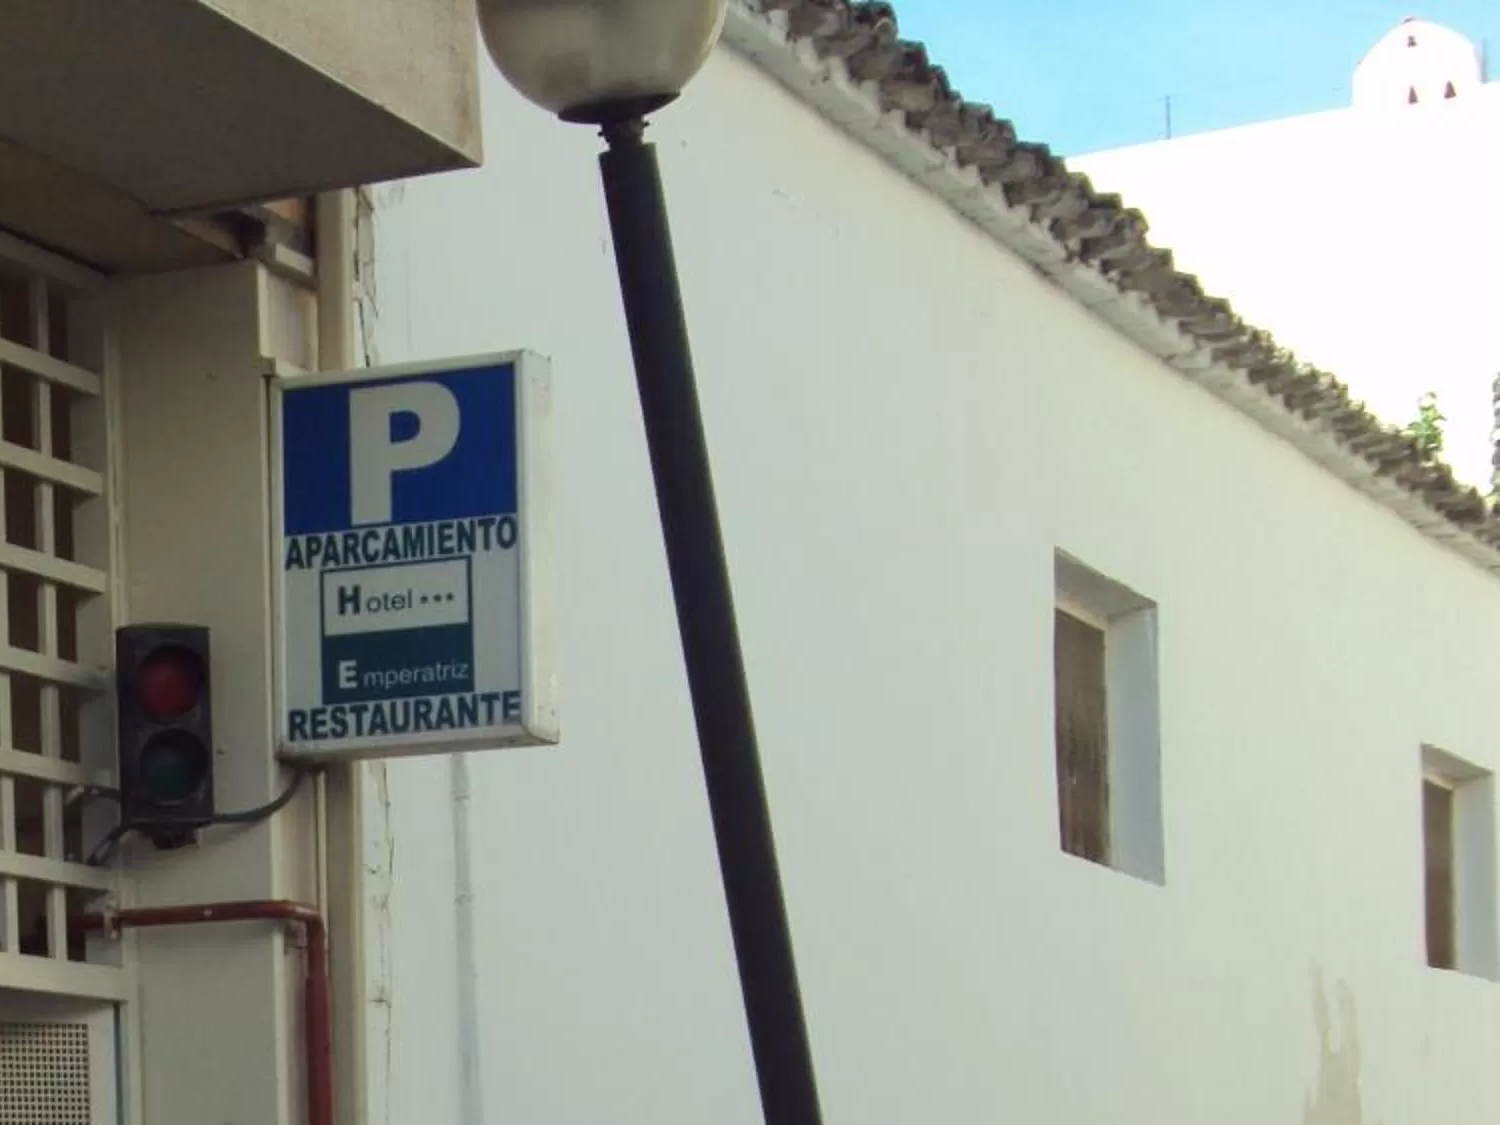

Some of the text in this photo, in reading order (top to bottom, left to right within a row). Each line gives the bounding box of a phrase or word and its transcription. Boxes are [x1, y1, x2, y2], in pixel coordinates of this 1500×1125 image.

[349, 380, 461, 527] P
[285, 515, 518, 571] APARCAMIENTO
[337, 584, 413, 616] Hotel
[338, 660, 469, 690] Emperatriz
[287, 690, 522, 742] RESTAURANTE
